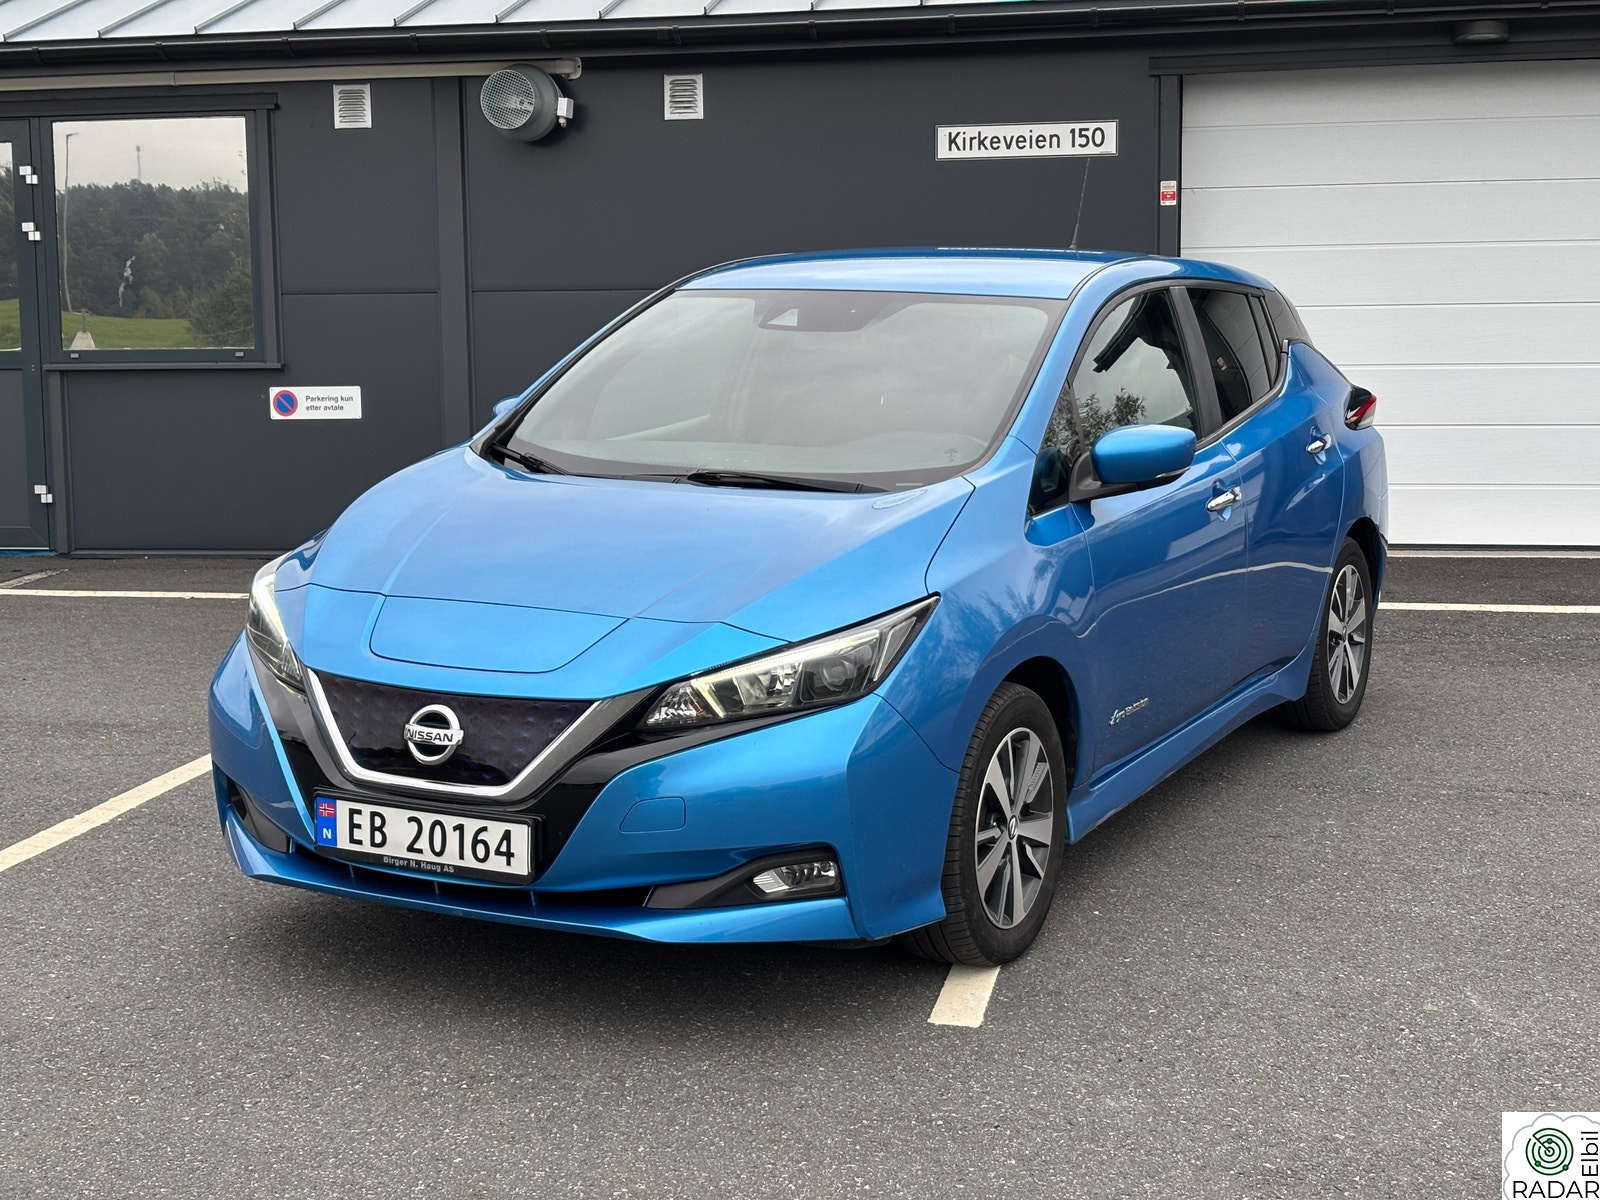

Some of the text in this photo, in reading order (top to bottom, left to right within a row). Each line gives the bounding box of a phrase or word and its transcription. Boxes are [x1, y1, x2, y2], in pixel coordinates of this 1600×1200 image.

[948, 127, 1105, 151] Kirkeveien 150
[305, 395, 339, 403] Parkering
[406, 728, 454, 743] NISSAN
[322, 828, 332, 840] N
[348, 807, 515, 867] EB 20164
[383, 855, 455, 873] Birger N. Haug AS
